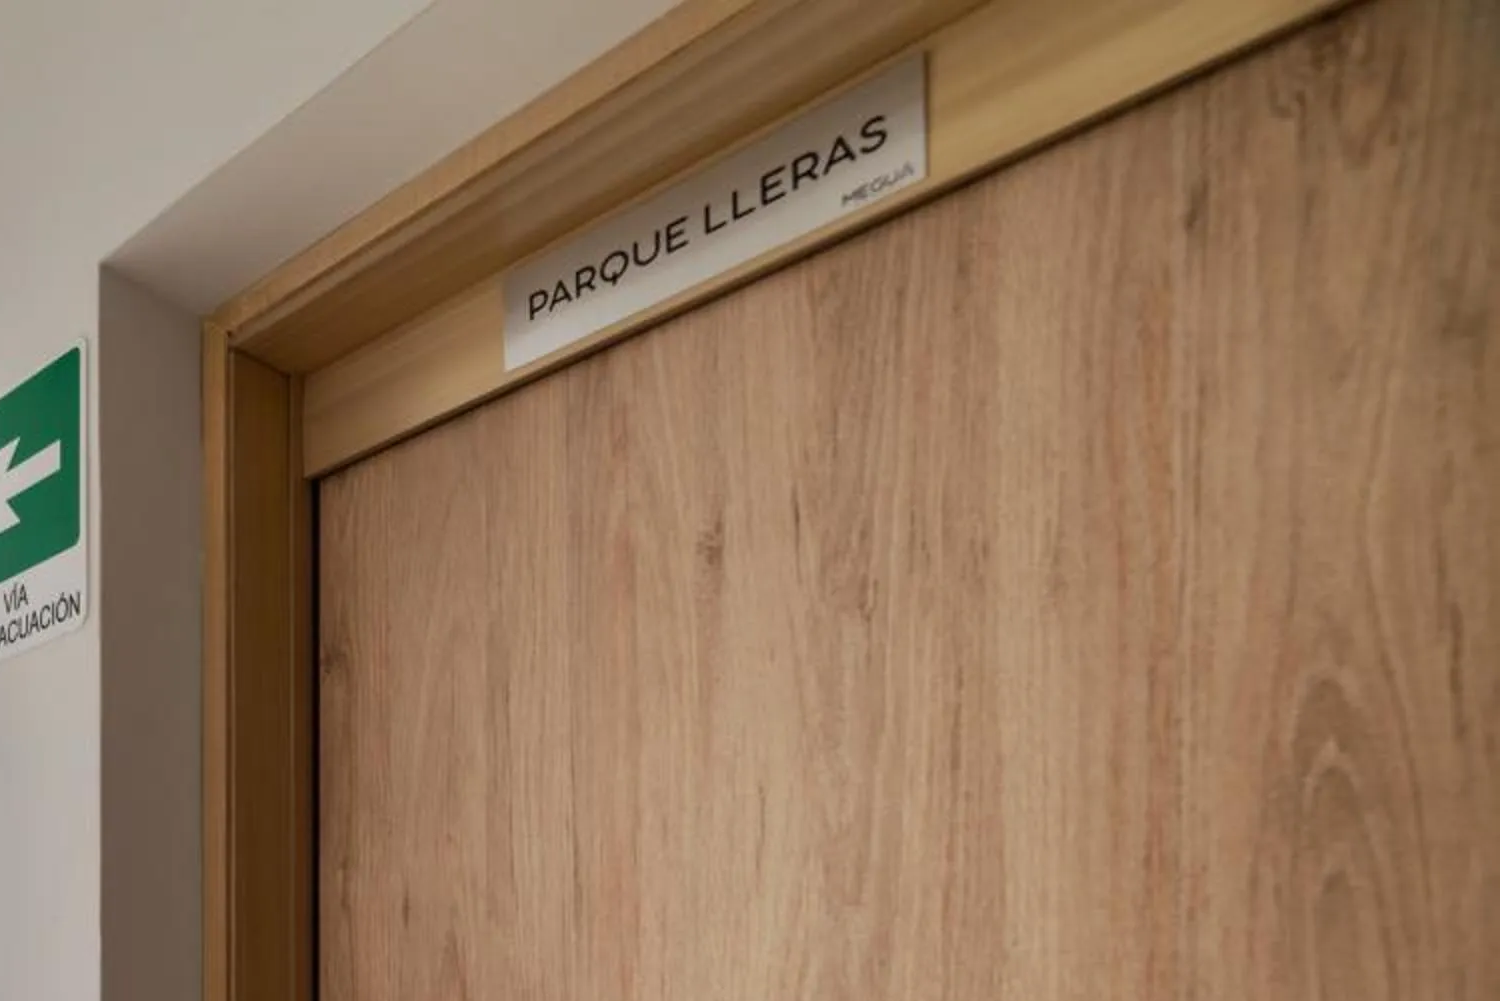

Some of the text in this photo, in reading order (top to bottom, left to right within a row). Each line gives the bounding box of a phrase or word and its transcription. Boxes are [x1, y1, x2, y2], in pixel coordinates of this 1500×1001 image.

[528, 114, 889, 321] PARQUE LLERAS
[3, 582, 29, 614] VÍA
